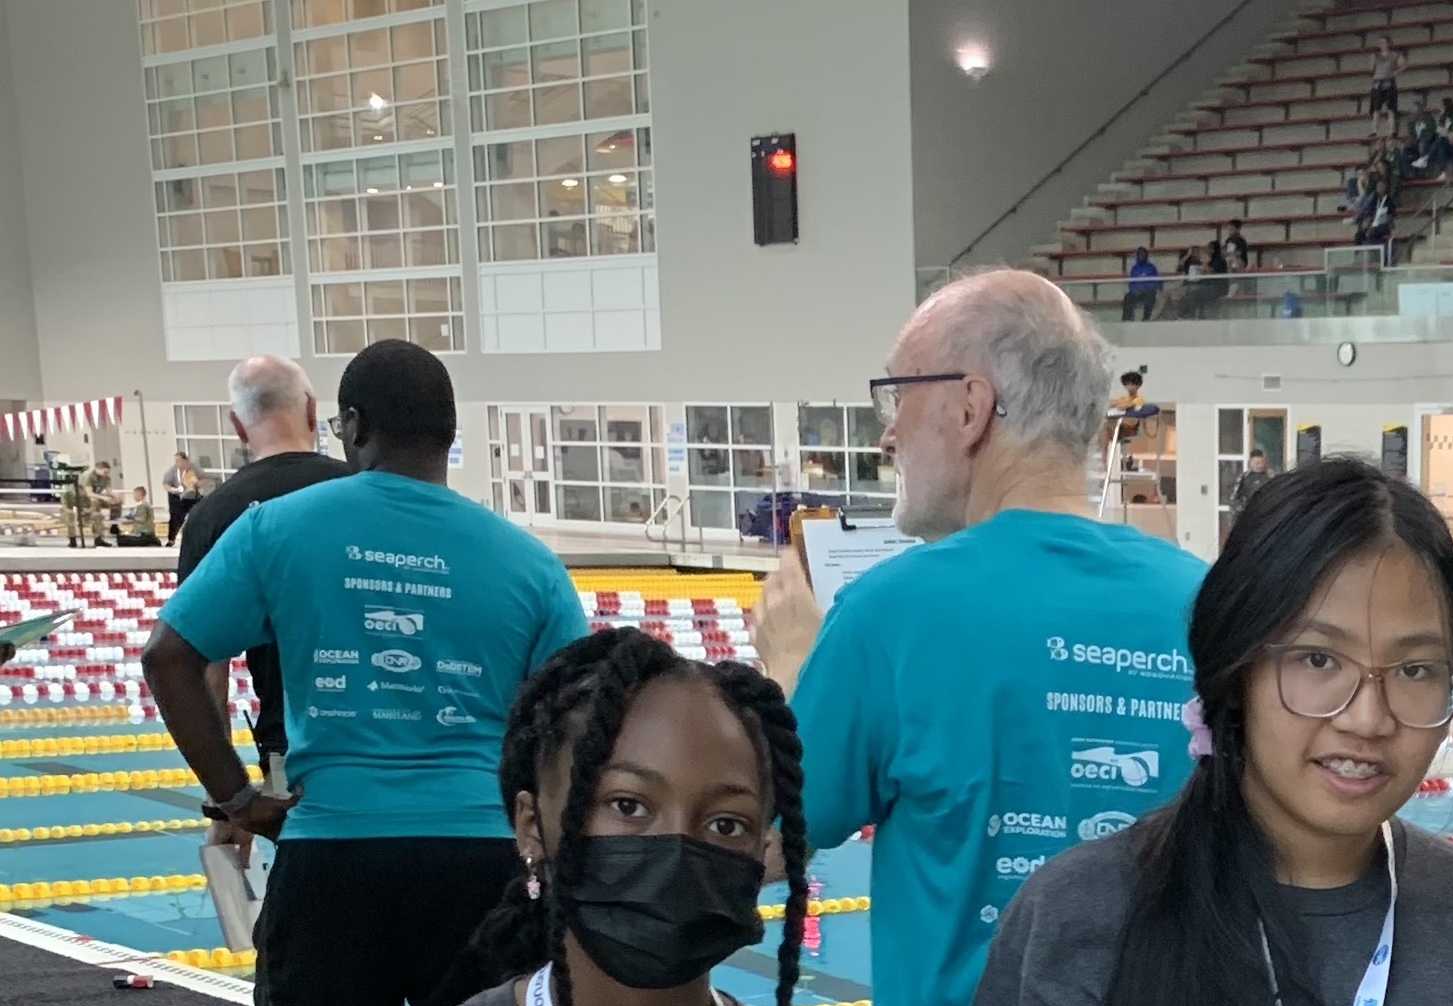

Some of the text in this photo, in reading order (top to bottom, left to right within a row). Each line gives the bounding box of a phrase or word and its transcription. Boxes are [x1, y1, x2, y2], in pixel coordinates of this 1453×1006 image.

[364, 548, 446, 569] seaperch
[344, 578, 393, 593] SPONSORS
[405, 583, 452, 598] PARTNERS
[319, 650, 359, 659] OCEAN
[1073, 643, 1188, 672] seaperch
[1047, 692, 1186, 721] SPONSORS & PARTNE
[1003, 812, 1067, 829] OCEAN
